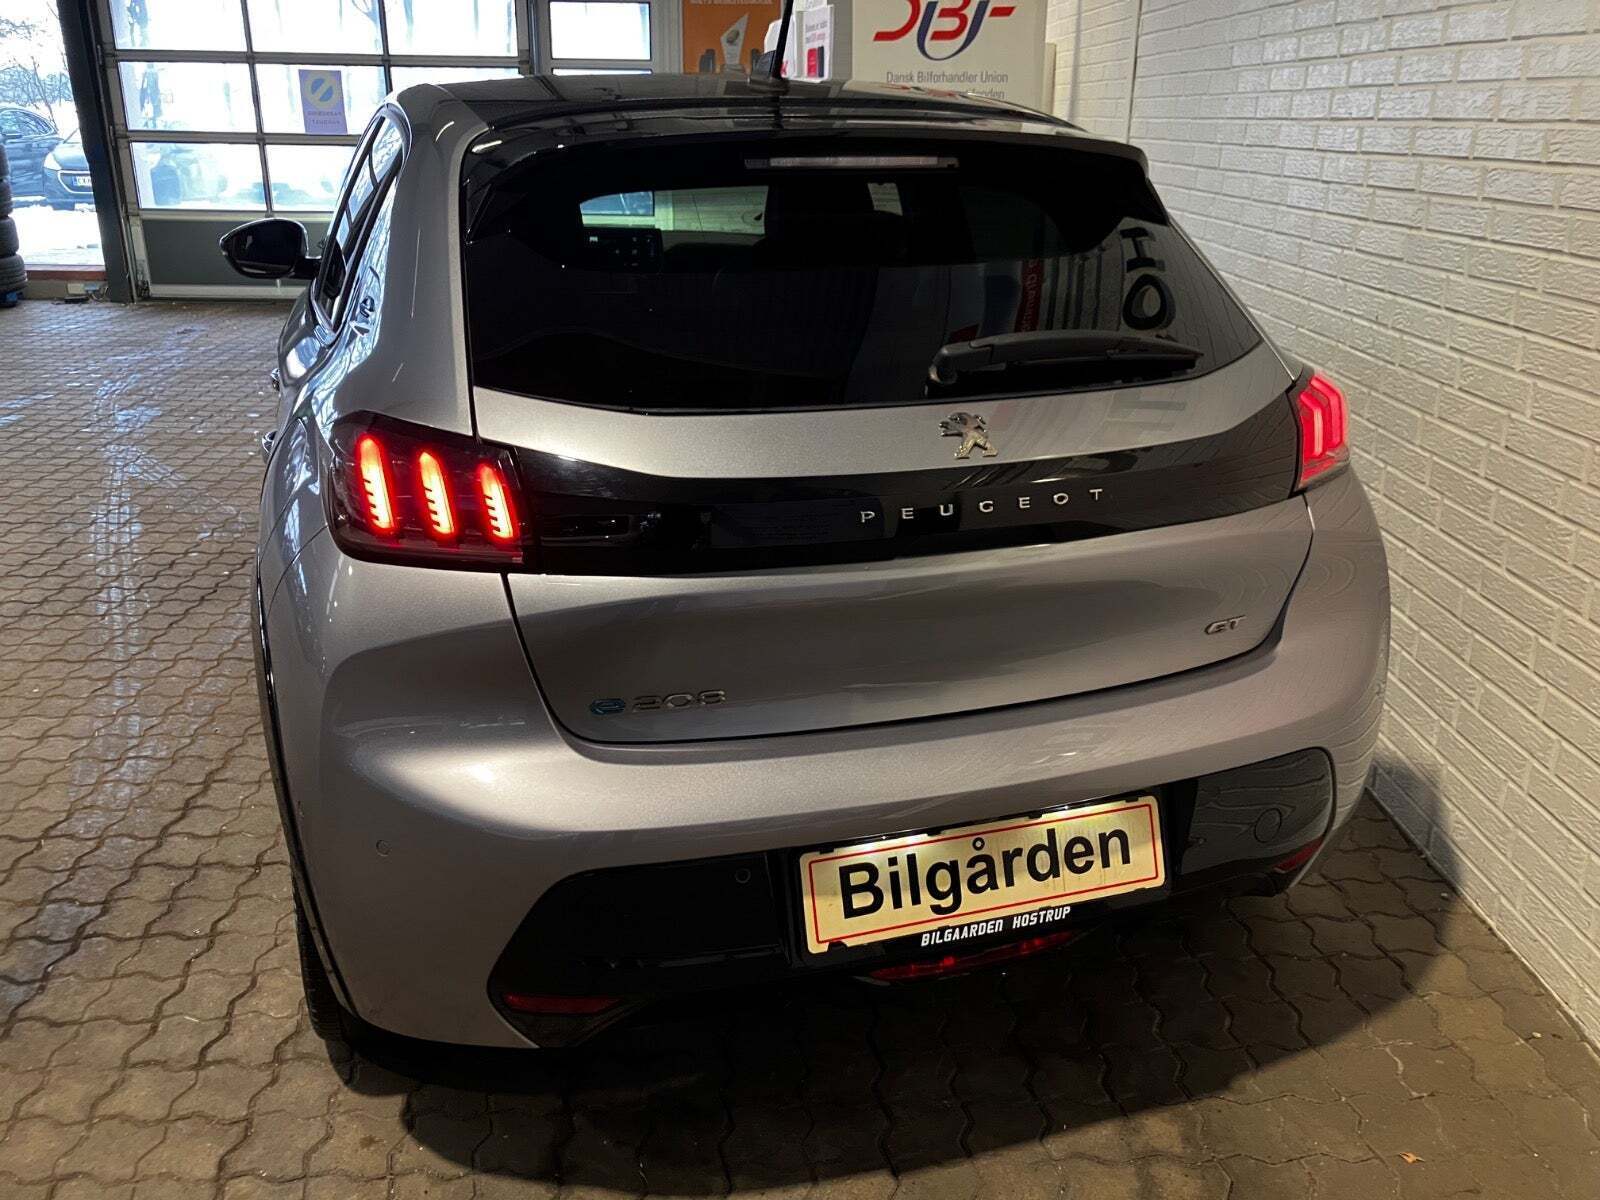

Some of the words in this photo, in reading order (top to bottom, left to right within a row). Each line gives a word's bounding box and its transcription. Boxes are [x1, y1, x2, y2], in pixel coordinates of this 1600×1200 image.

[886, 71, 914, 83] Dansk
[917, 71, 978, 83] Bilforhandler
[980, 71, 1009, 83] Union
[860, 488, 1103, 523] PEUGEOT
[1204, 614, 1247, 635] GT
[838, 826, 1131, 920] Bilgården
[920, 919, 1004, 947] BILGAARDEN
[1012, 905, 1071, 929] HOSTRUP
